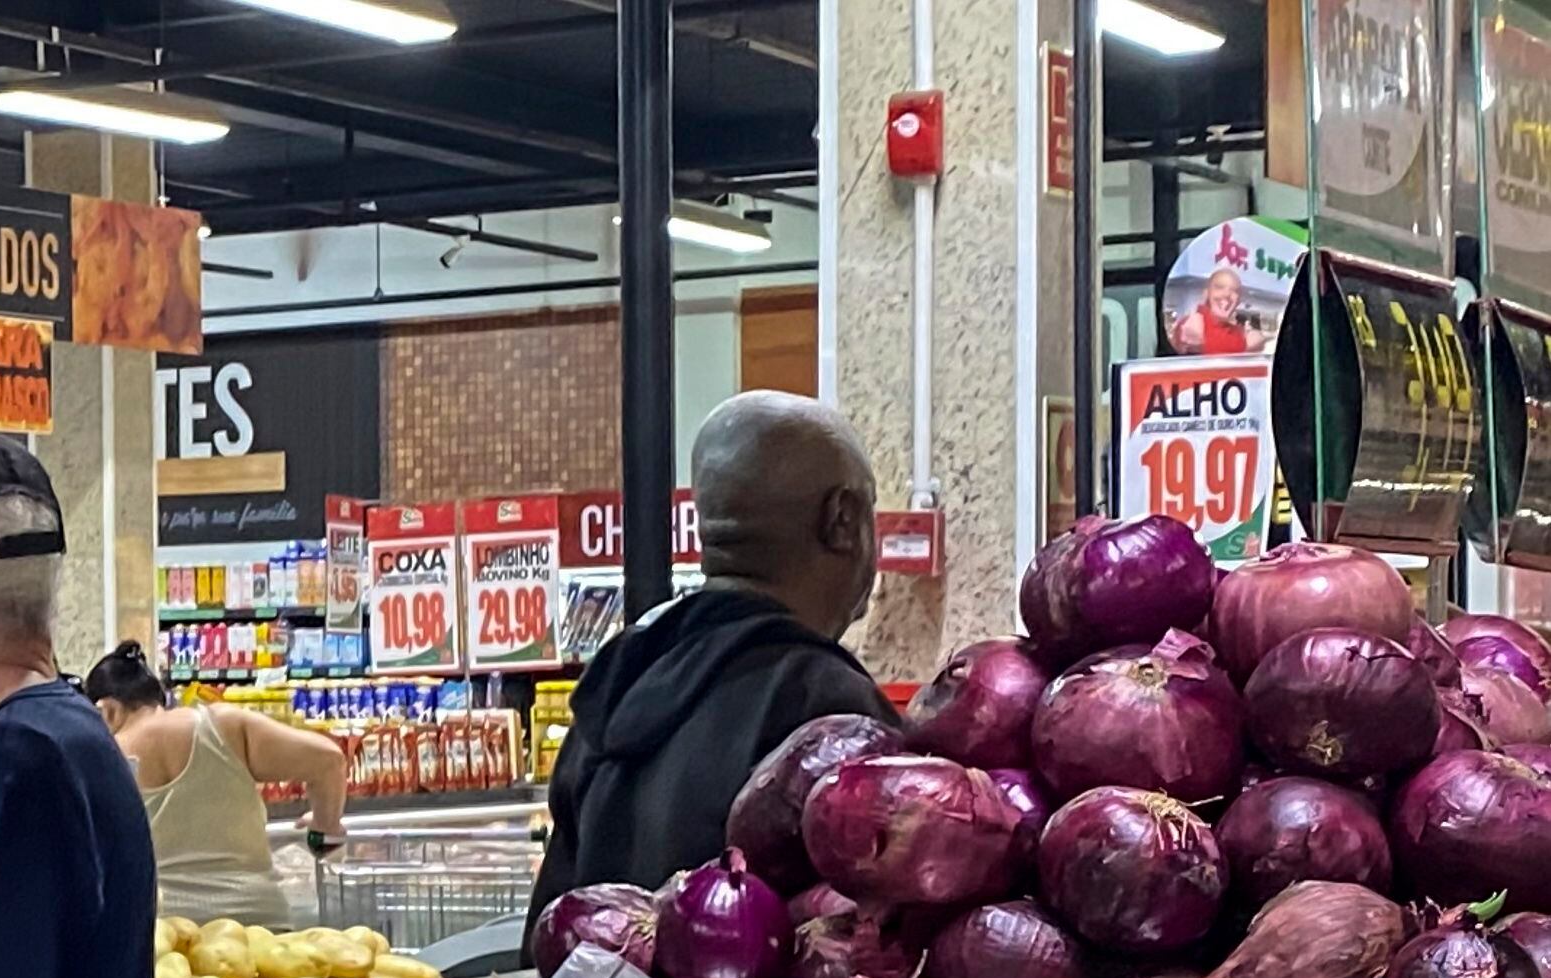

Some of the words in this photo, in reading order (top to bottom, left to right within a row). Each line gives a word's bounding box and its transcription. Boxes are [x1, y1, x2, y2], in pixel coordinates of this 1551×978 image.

[154, 362, 254, 459] TES
[1143, 378, 1247, 419] ALHO
[1141, 435, 1259, 534] 19,97
[378, 548, 446, 574] COXA
[476, 544, 549, 571] LOMBINHO
[378, 592, 446, 653] 10,98
[478, 586, 547, 648] 29,98
